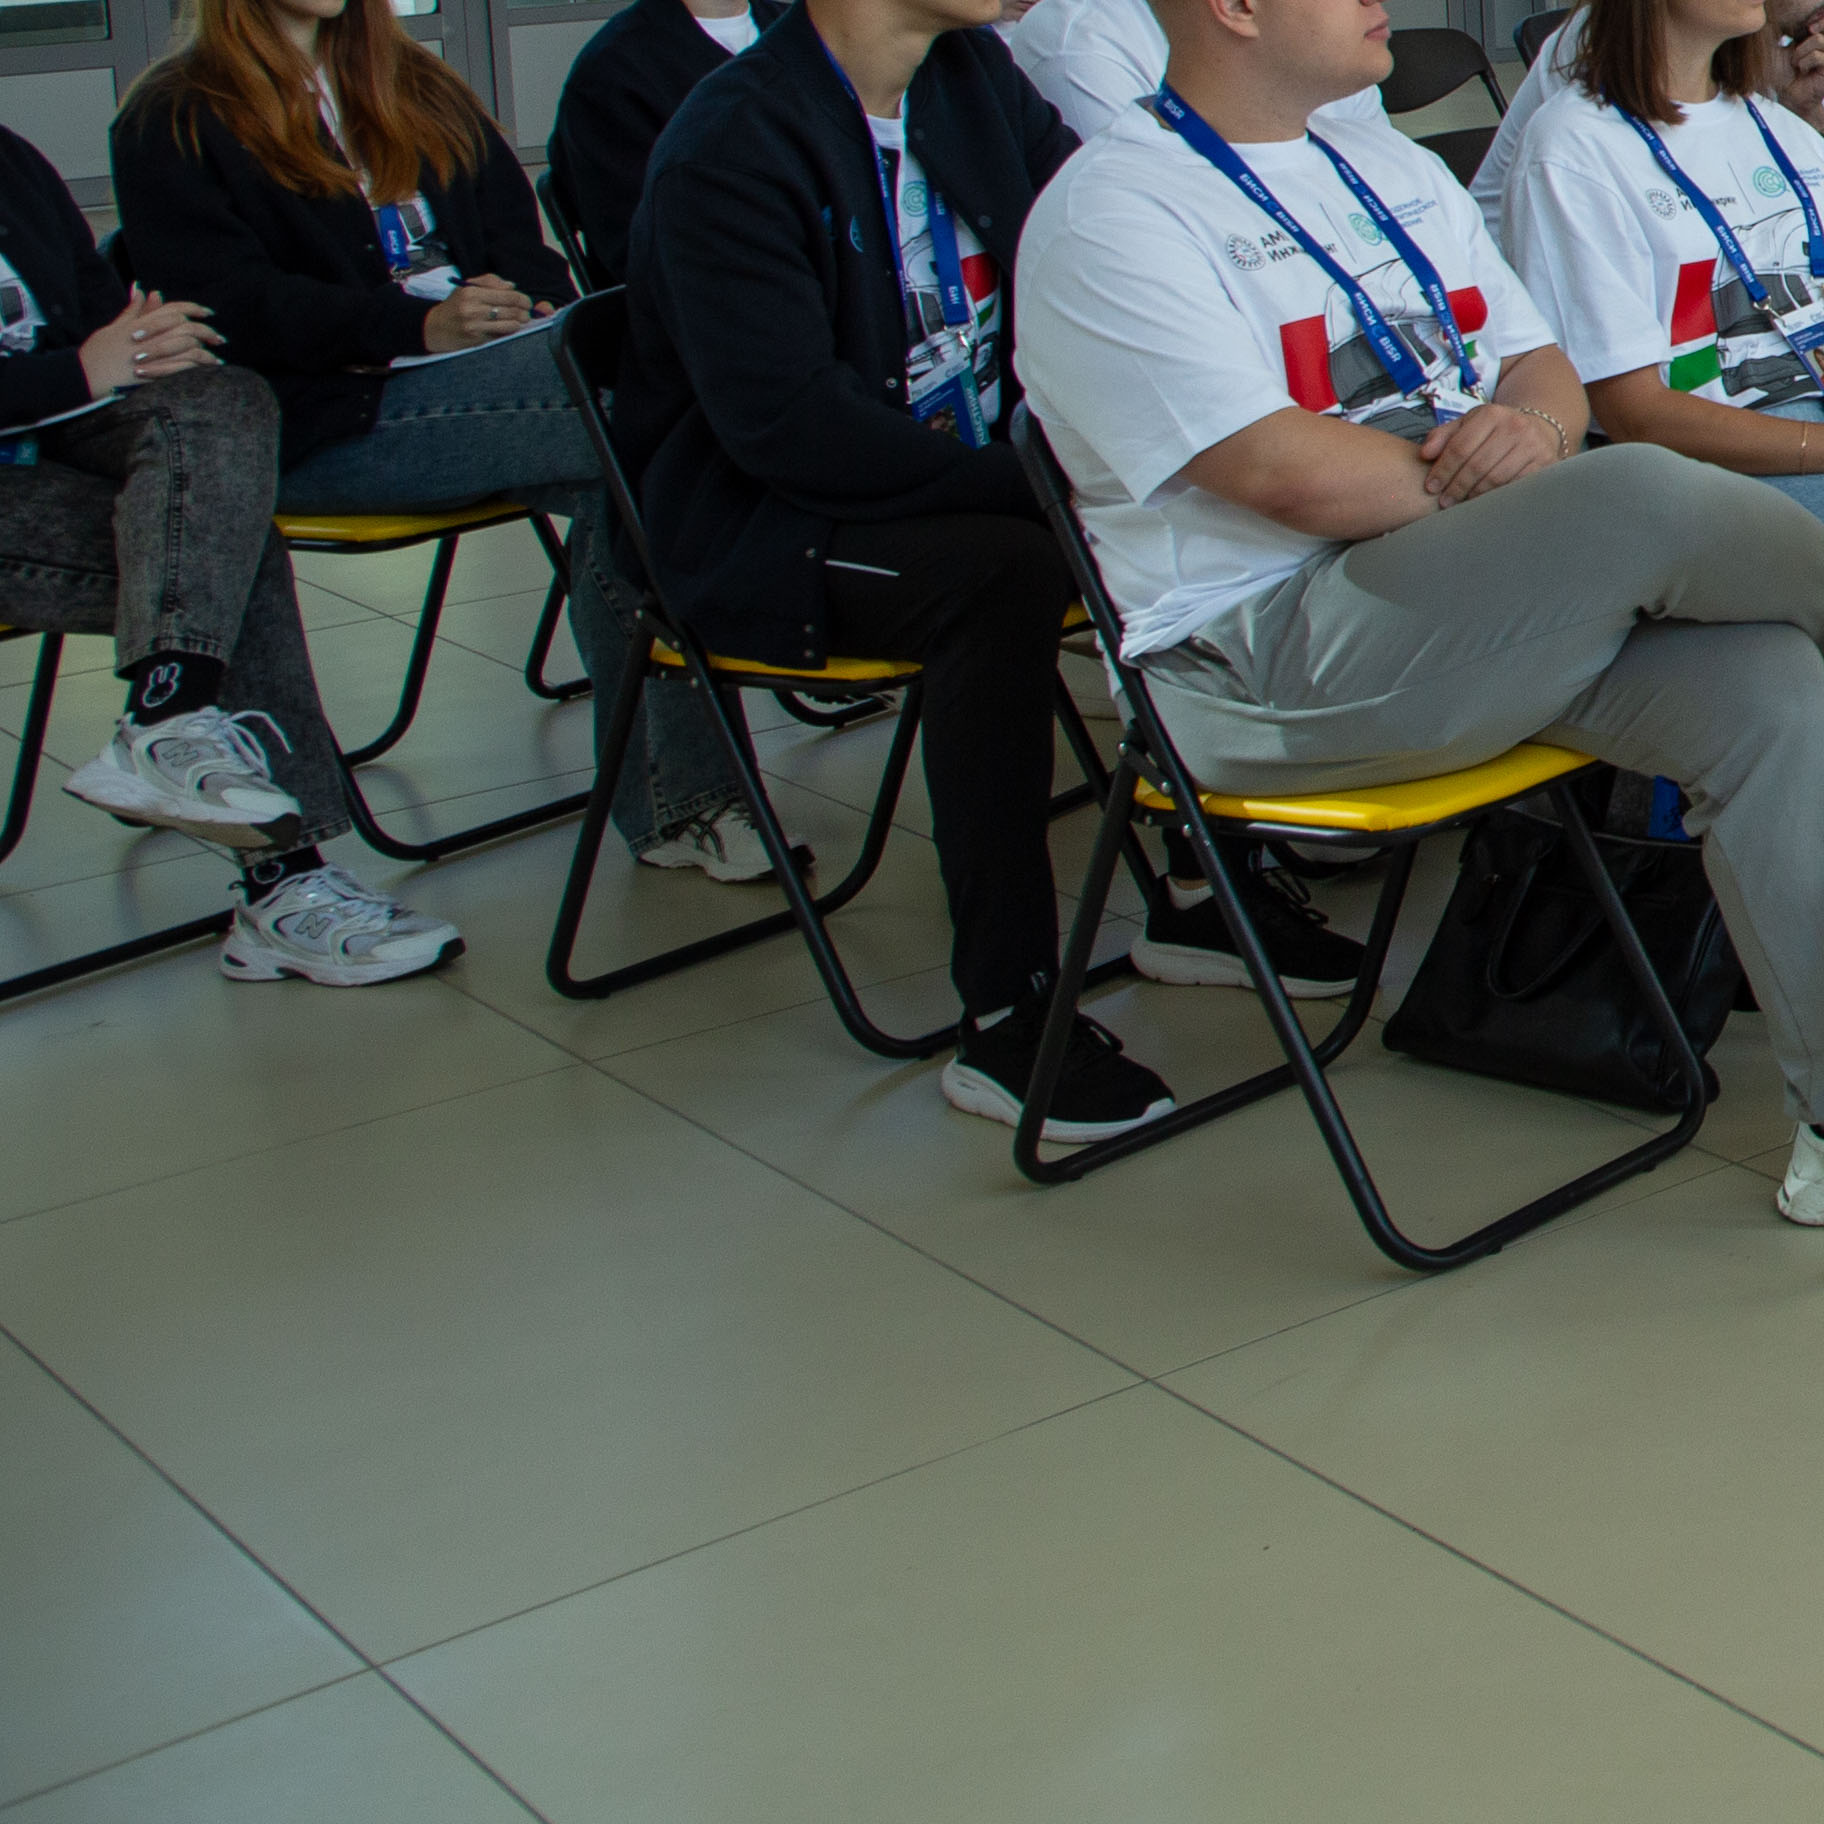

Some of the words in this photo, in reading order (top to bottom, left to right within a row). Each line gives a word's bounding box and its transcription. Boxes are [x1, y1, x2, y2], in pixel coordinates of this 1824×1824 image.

[1239, 173, 1269, 202] БИСИ
[1275, 211, 1300, 233] BISR
[1363, 194, 1388, 222] БИСИ
[1717, 226, 1737, 254] БИСИ
[1430, 283, 1446, 311] BISR
[1354, 292, 1377, 326] БИСИ
[1379, 336, 1402, 363] BISR
